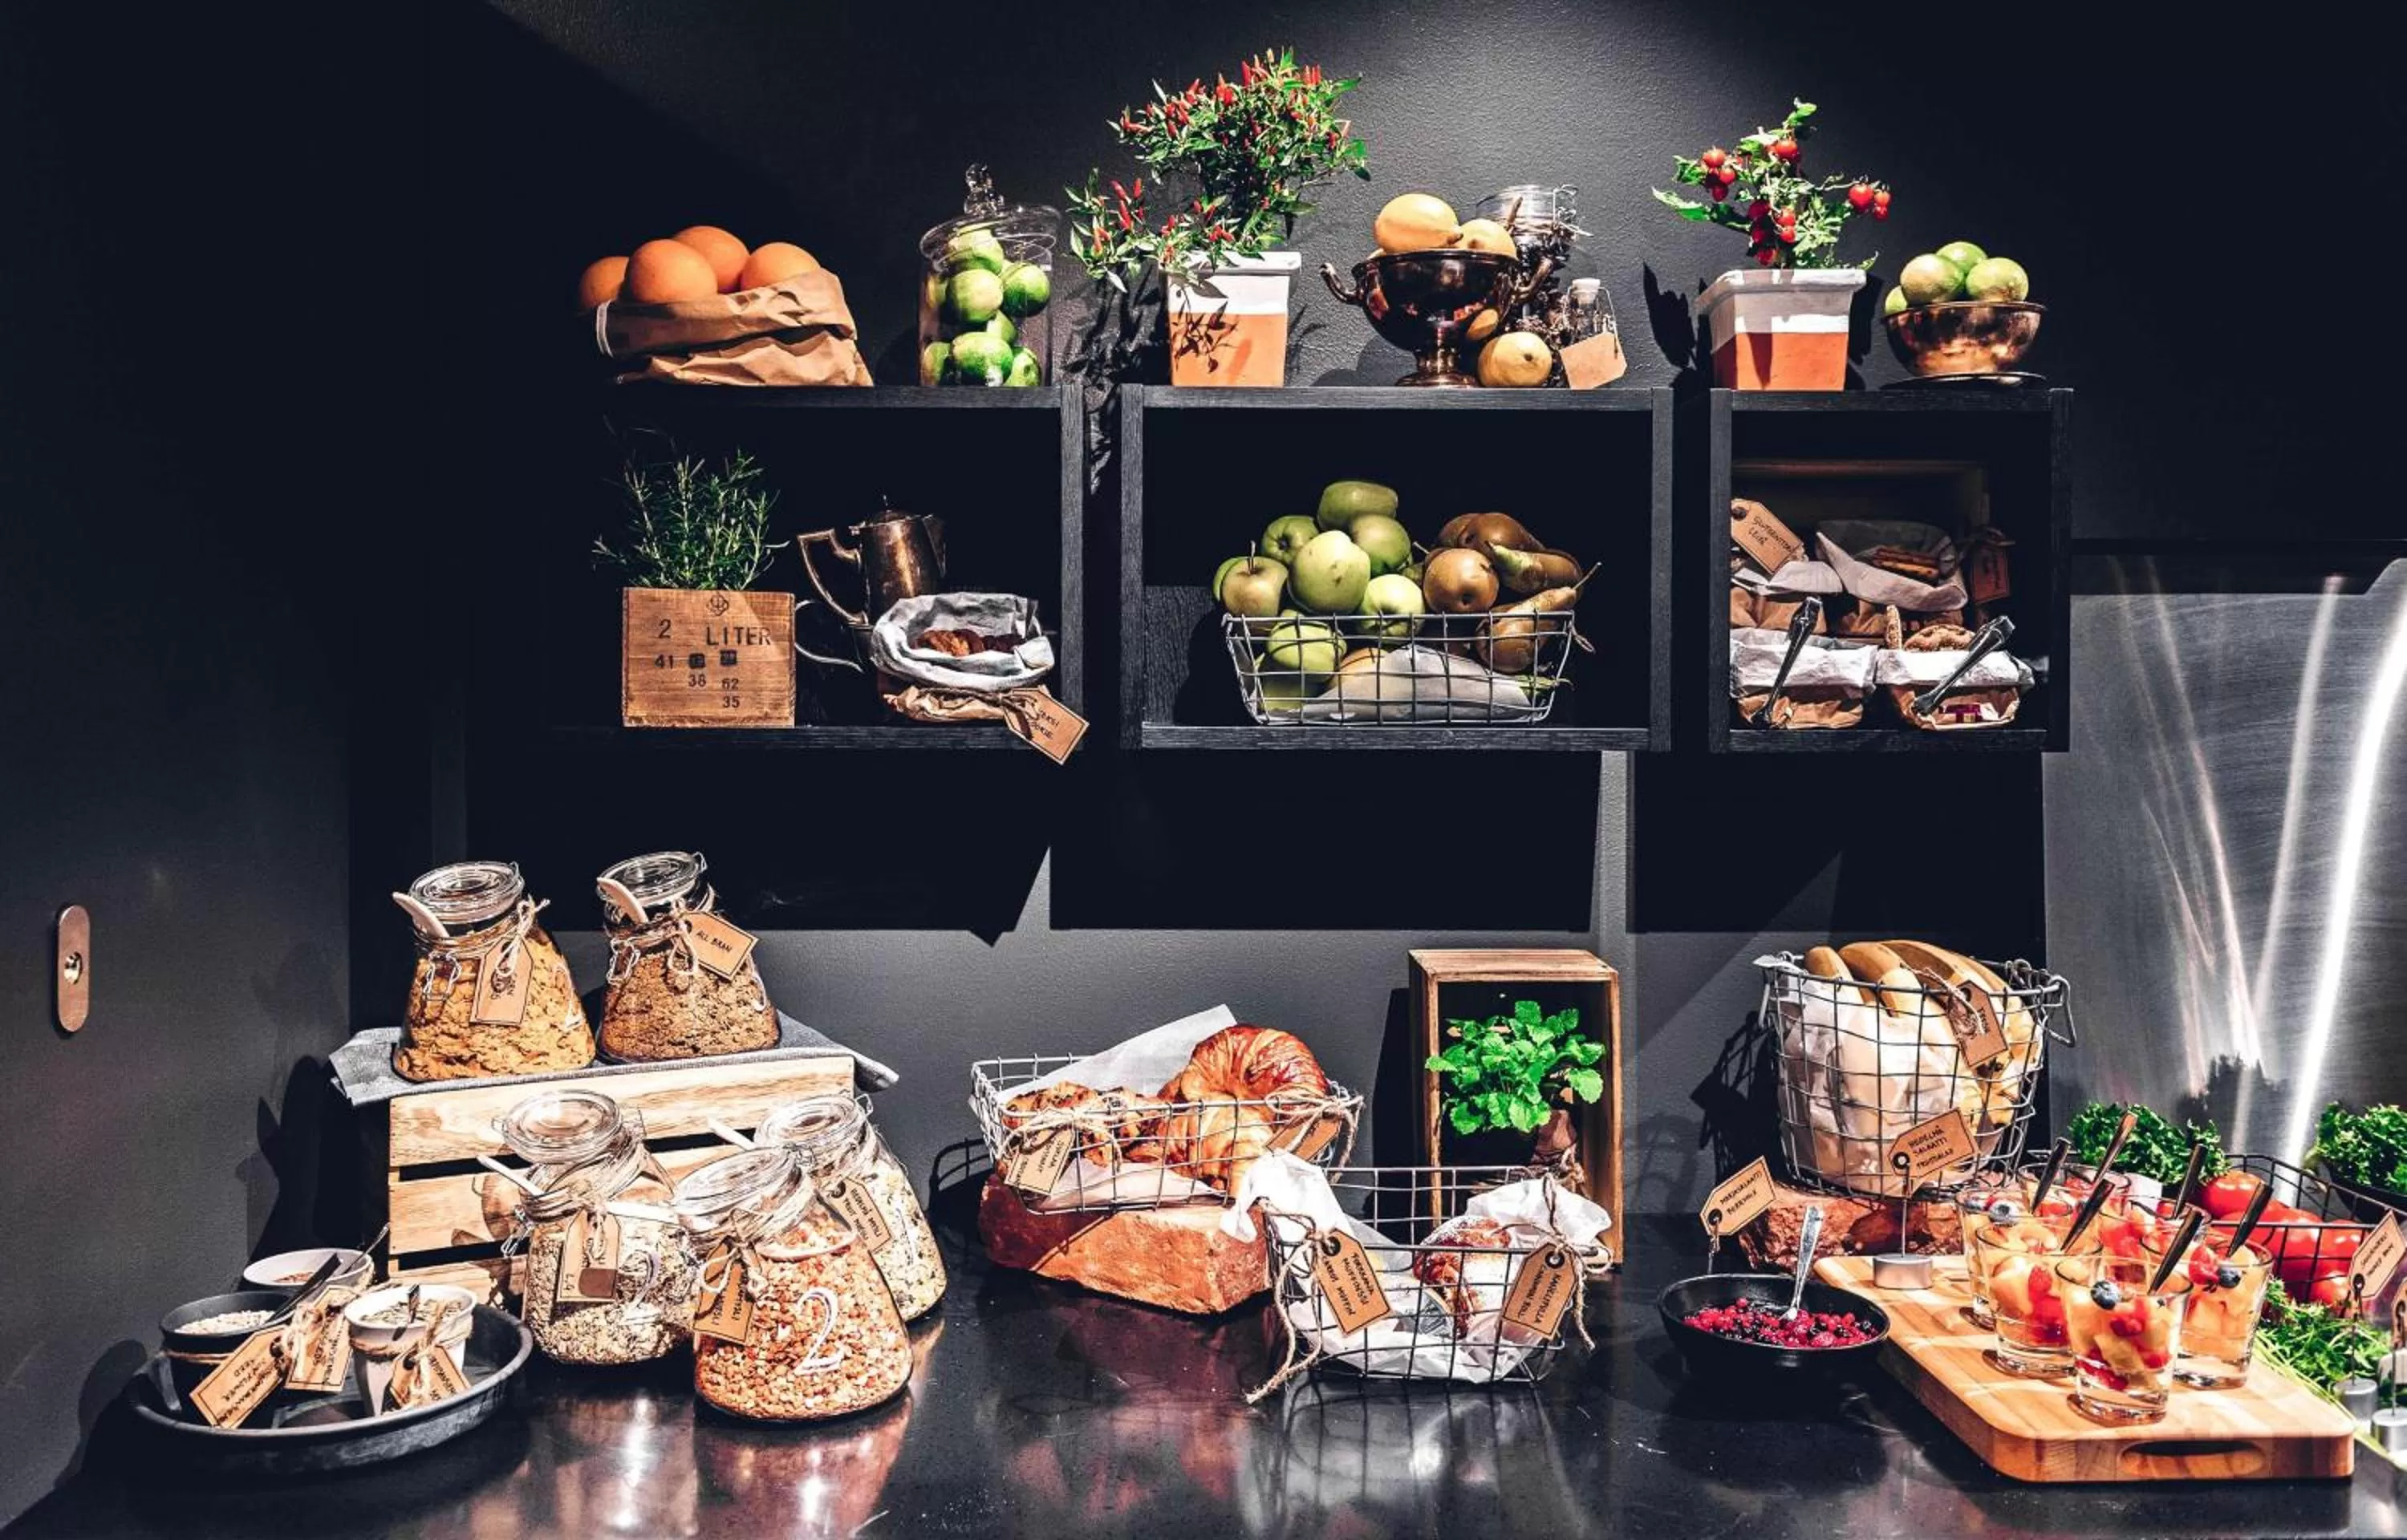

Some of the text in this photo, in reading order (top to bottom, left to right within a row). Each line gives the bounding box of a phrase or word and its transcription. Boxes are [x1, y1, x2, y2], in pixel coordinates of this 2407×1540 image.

[658, 619, 771, 646] 2 LITER
[655, 654, 674, 669] 41
[688, 674, 706, 687] 38
[723, 695, 740, 708] 35
[1335, 1285, 1356, 1316] MUFFIN
[792, 1287, 846, 1376] 2
